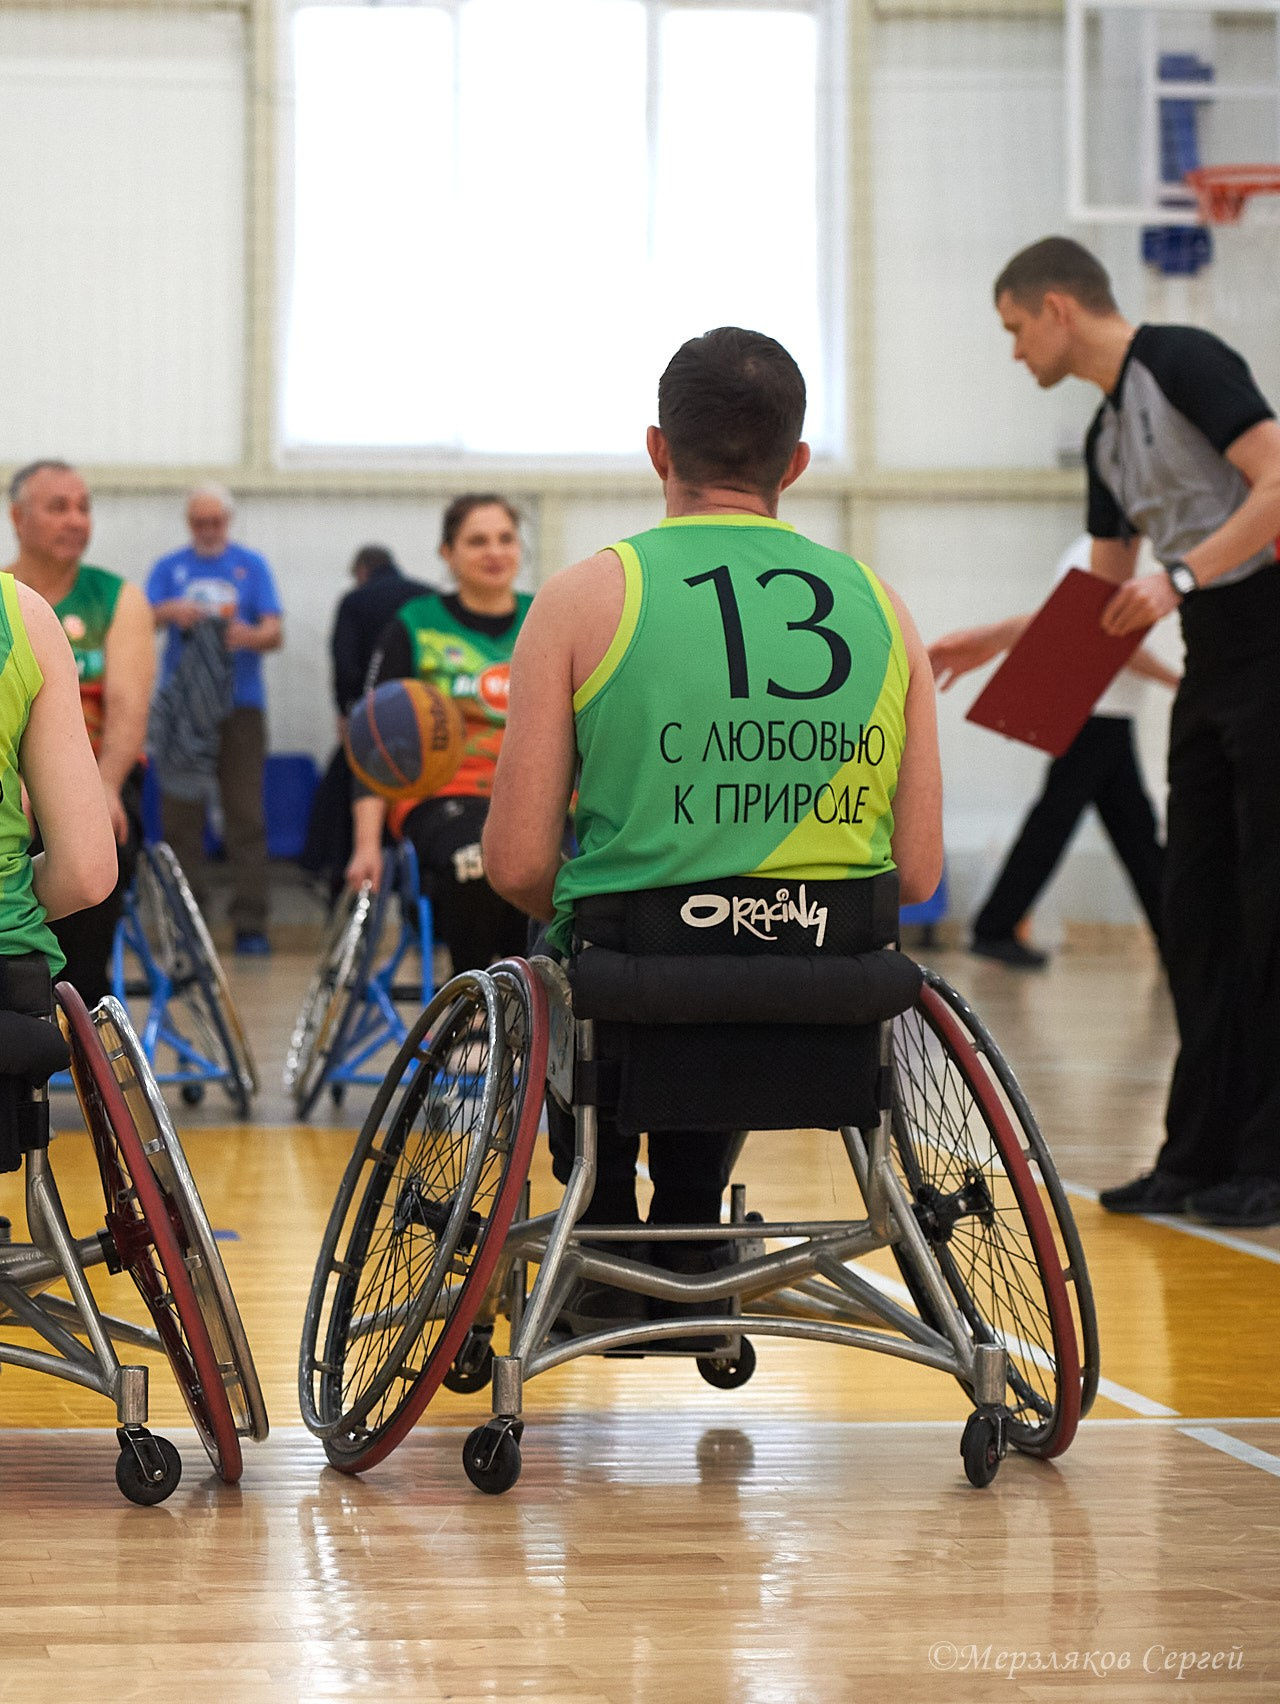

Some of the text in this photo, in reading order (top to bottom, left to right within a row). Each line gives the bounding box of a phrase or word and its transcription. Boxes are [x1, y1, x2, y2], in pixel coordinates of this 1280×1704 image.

[683, 564, 853, 701] 13
[659, 719, 886, 767] С ЛЮБОВЬЮ
[673, 782, 870, 826] К ПРИРОДЕ
